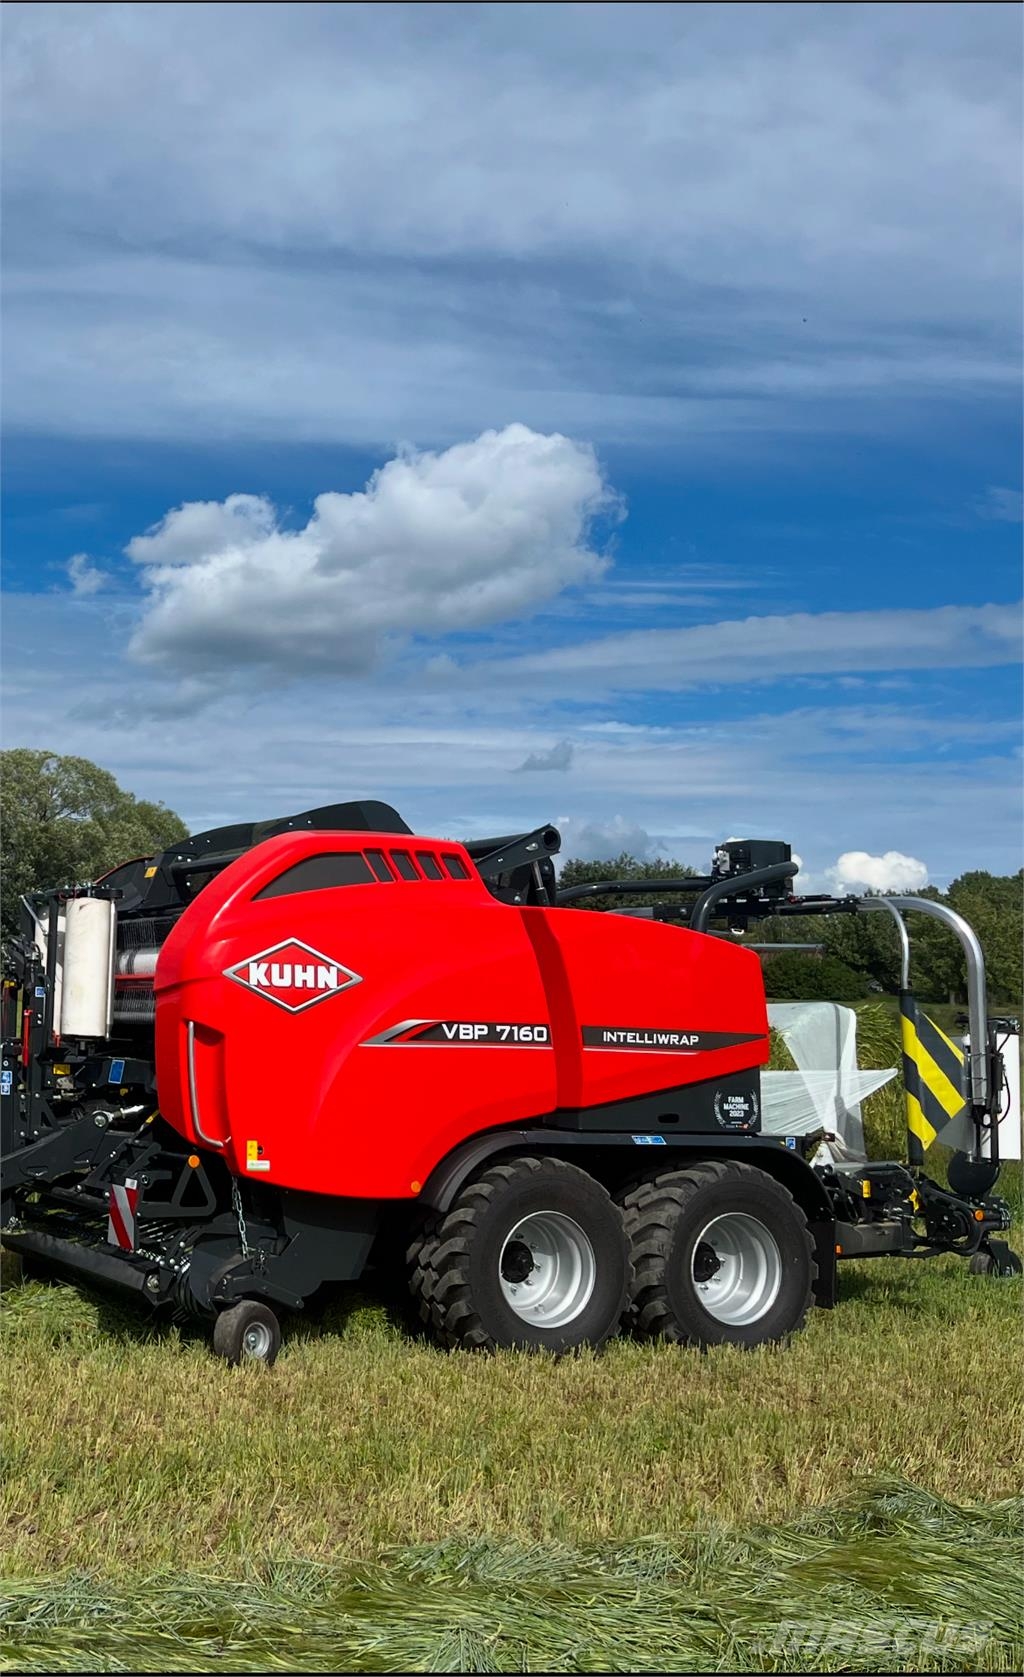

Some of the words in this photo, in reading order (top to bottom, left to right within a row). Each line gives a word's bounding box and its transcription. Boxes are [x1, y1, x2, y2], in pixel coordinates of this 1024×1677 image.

[249, 962, 338, 989] KUHN
[441, 1023, 489, 1040] VBP
[495, 1025, 548, 1042] 7160
[602, 1031, 699, 1046] INTELLIWRAP
